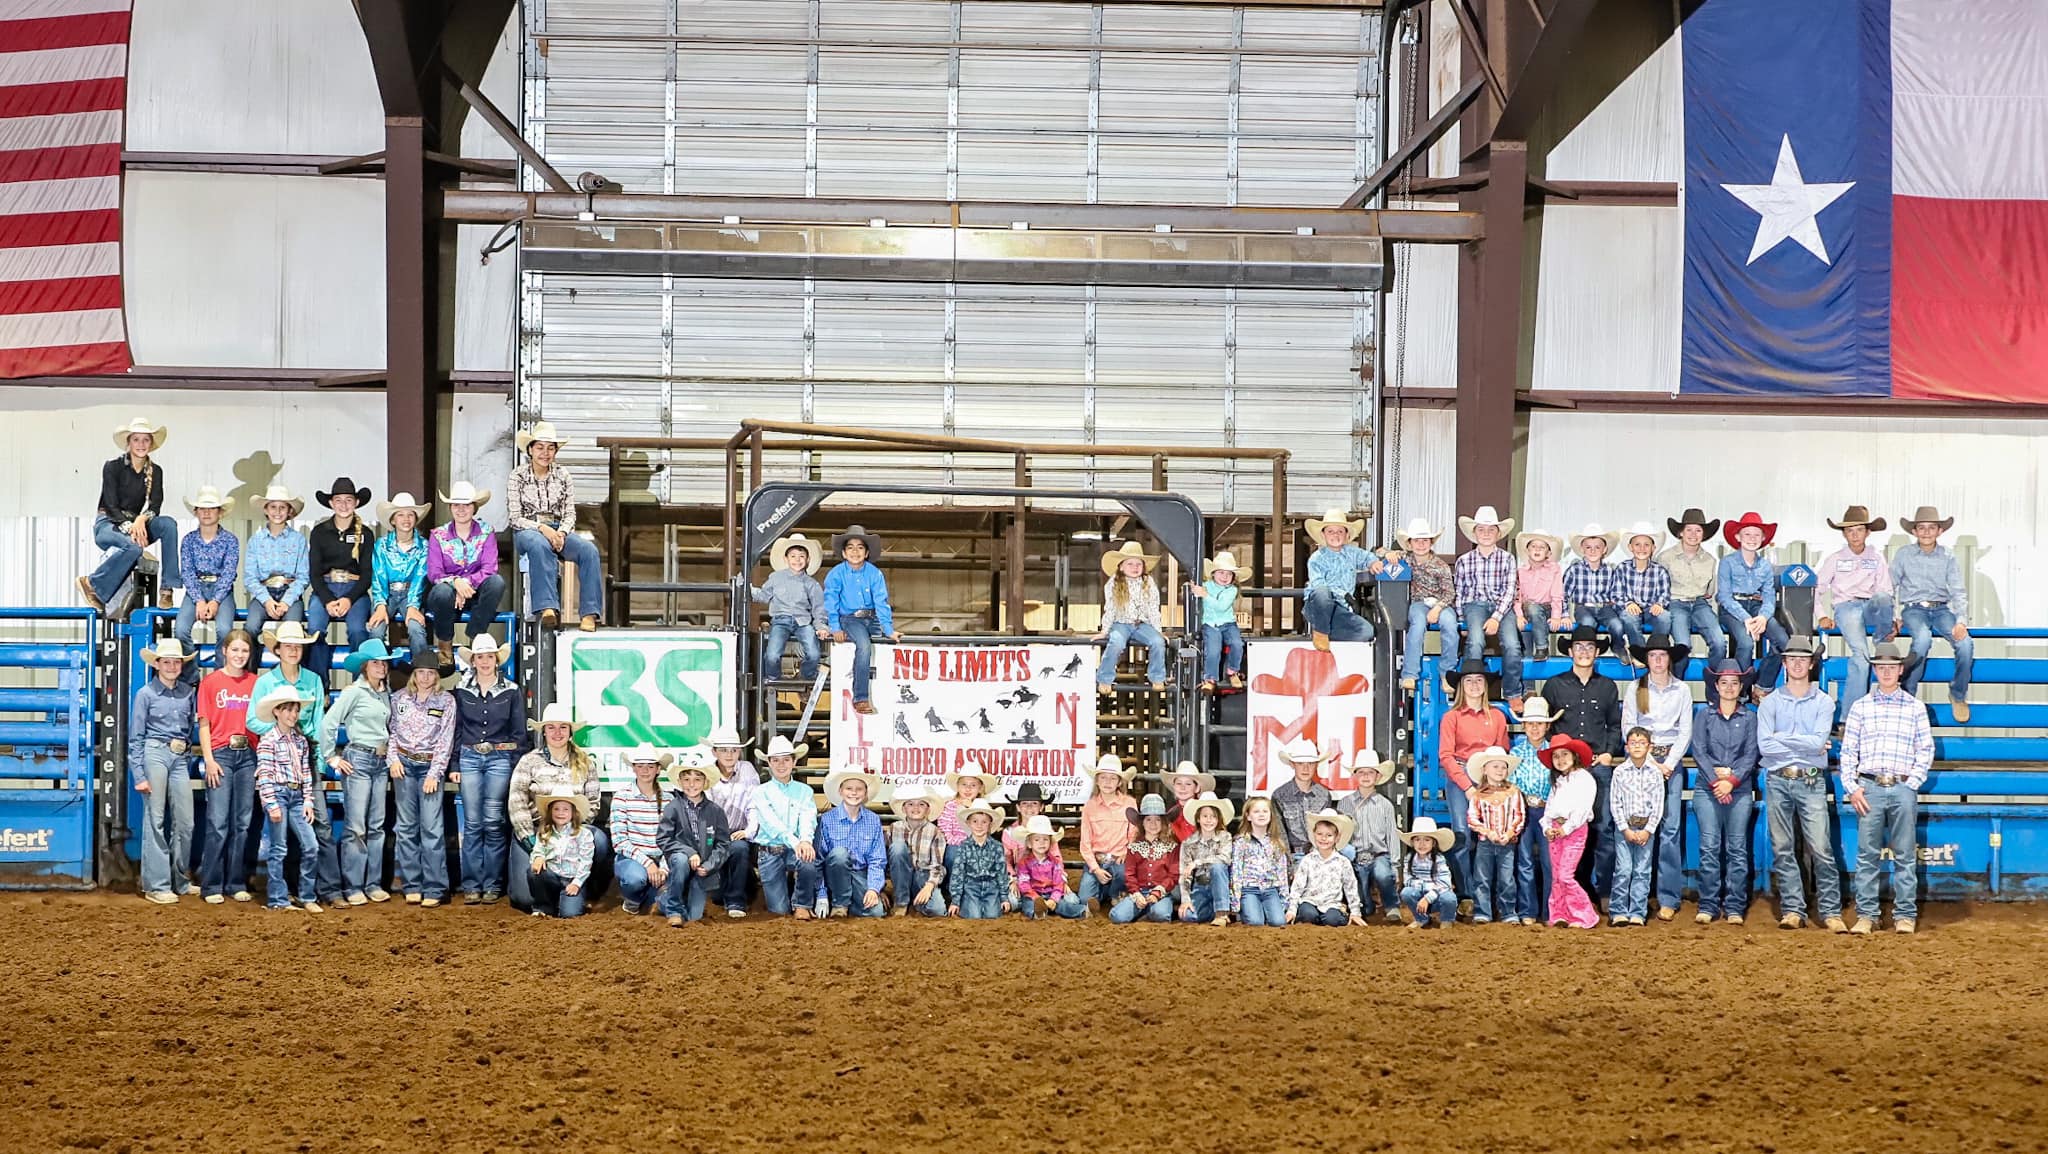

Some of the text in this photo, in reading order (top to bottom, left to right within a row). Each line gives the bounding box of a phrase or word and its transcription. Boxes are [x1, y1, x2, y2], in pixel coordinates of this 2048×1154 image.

[892, 649, 1031, 682] NO LIMITS
[103, 640, 117, 818] Priefert
[881, 746, 948, 776] RODEO
[895, 775, 921, 788] God
